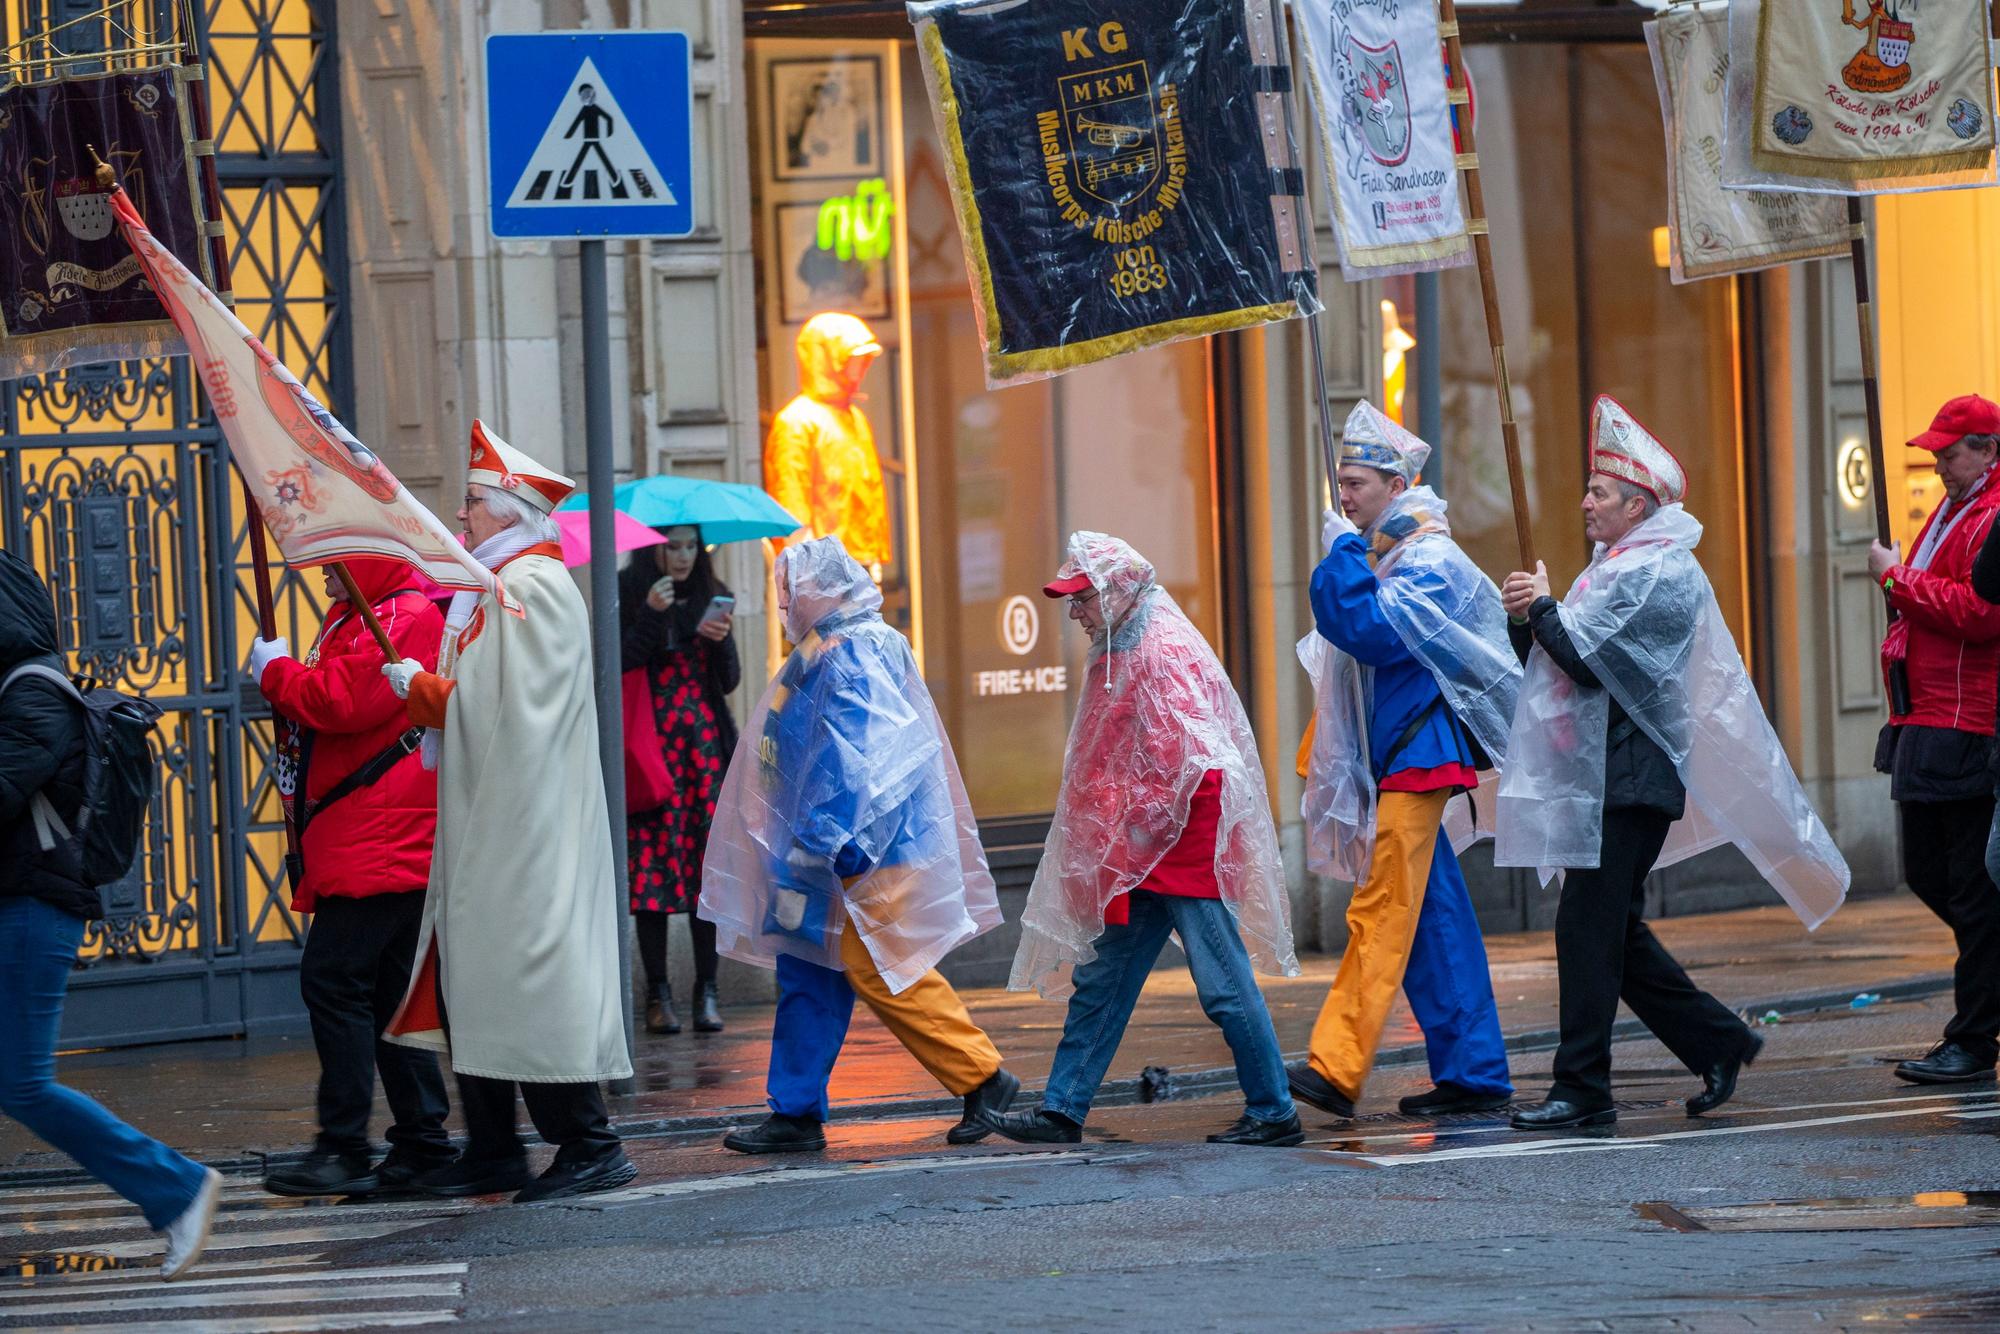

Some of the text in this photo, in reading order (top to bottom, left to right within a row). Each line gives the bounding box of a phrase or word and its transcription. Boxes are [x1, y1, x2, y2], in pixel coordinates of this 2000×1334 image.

[1061, 21, 1128, 61] KG
[1072, 73, 1135, 103] MKM
[1825, 80, 1941, 124] Kölsche för Kölsche
[1835, 121, 1858, 136] vun
[1863, 122, 1902, 140] 1994
[1036, 109, 1089, 230] Musikcorps
[1092, 207, 1163, 244] Kölsche
[1385, 166, 1447, 192] Sandhasen
[1113, 244, 1156, 271] von
[1110, 262, 1168, 298] 1983
